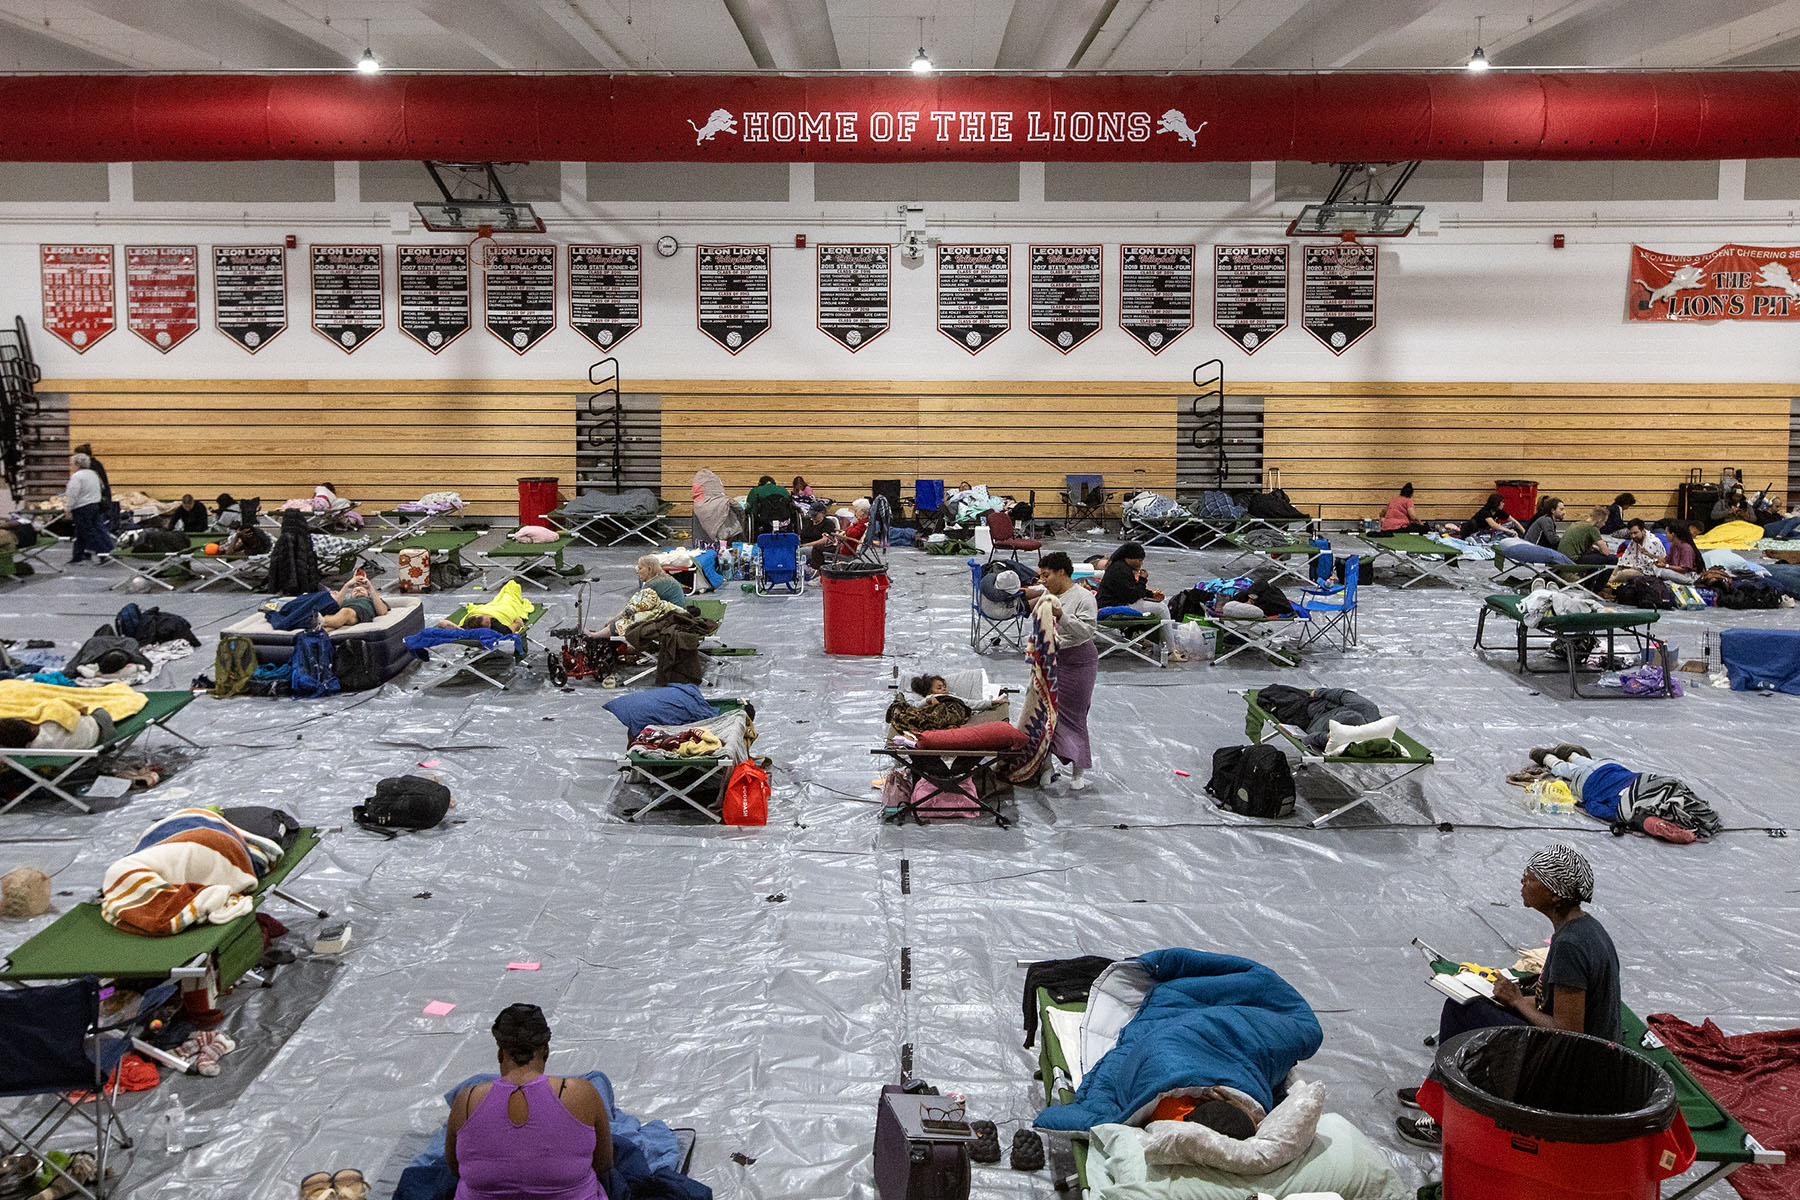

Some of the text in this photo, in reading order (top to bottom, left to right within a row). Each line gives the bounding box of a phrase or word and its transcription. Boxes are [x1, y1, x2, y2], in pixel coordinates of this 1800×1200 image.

[743, 112, 1151, 142] HOME OF THE LIONS
[1737, 248, 1787, 258] CHEERING
[1711, 272, 1752, 290] THE
[1667, 294, 1794, 317] LION'S PIT
